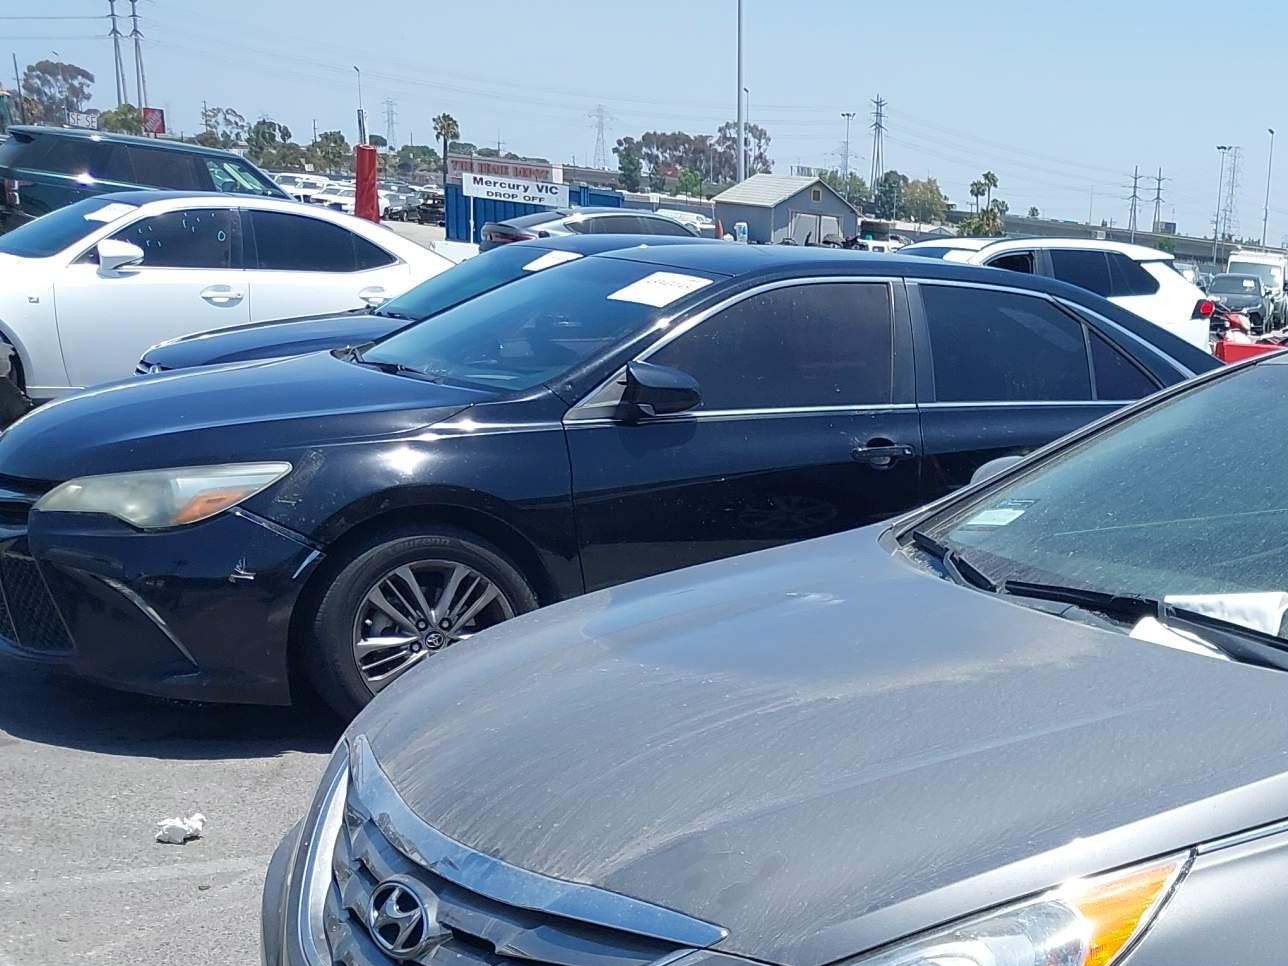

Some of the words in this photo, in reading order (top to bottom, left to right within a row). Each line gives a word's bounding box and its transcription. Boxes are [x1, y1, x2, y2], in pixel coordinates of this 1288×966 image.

[472, 176, 530, 193] Mercury
[535, 184, 559, 196] VIC
[486, 190, 518, 200] DROP
[523, 195, 545, 203] OFF
